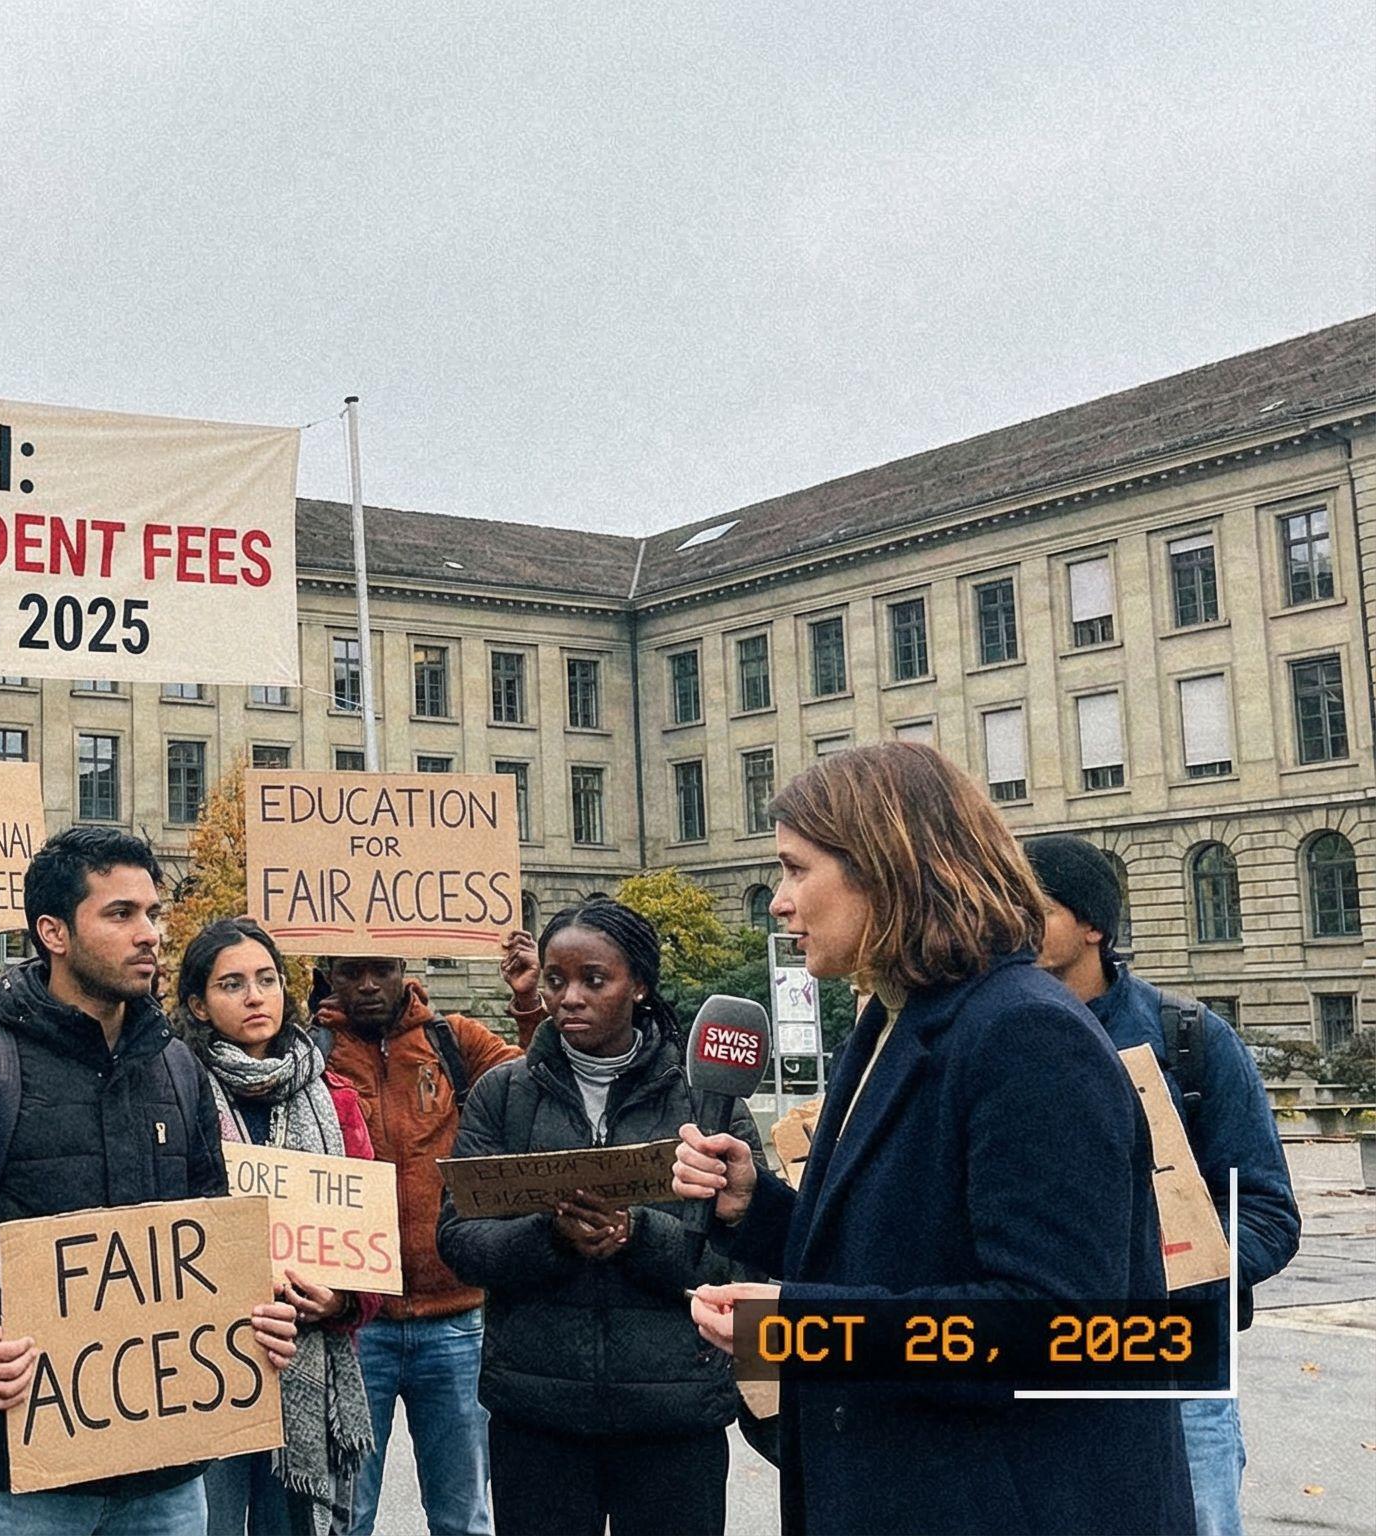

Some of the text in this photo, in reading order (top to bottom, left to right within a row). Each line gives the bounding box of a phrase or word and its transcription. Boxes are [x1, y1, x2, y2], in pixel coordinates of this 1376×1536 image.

[142, 523, 273, 588] FEES
[18, 593, 150, 655] 2025
[260, 784, 497, 829] EDUCATION
[350, 836, 402, 857] FOR
[263, 868, 514, 925] FAIR ACCESS
[703, 1042, 757, 1065] NEWS
[705, 1027, 759, 1049] SWISS
[309, 1169, 364, 1209] THE
[55, 1218, 218, 1318] FAIR
[23, 1317, 263, 1446] ACCESS
